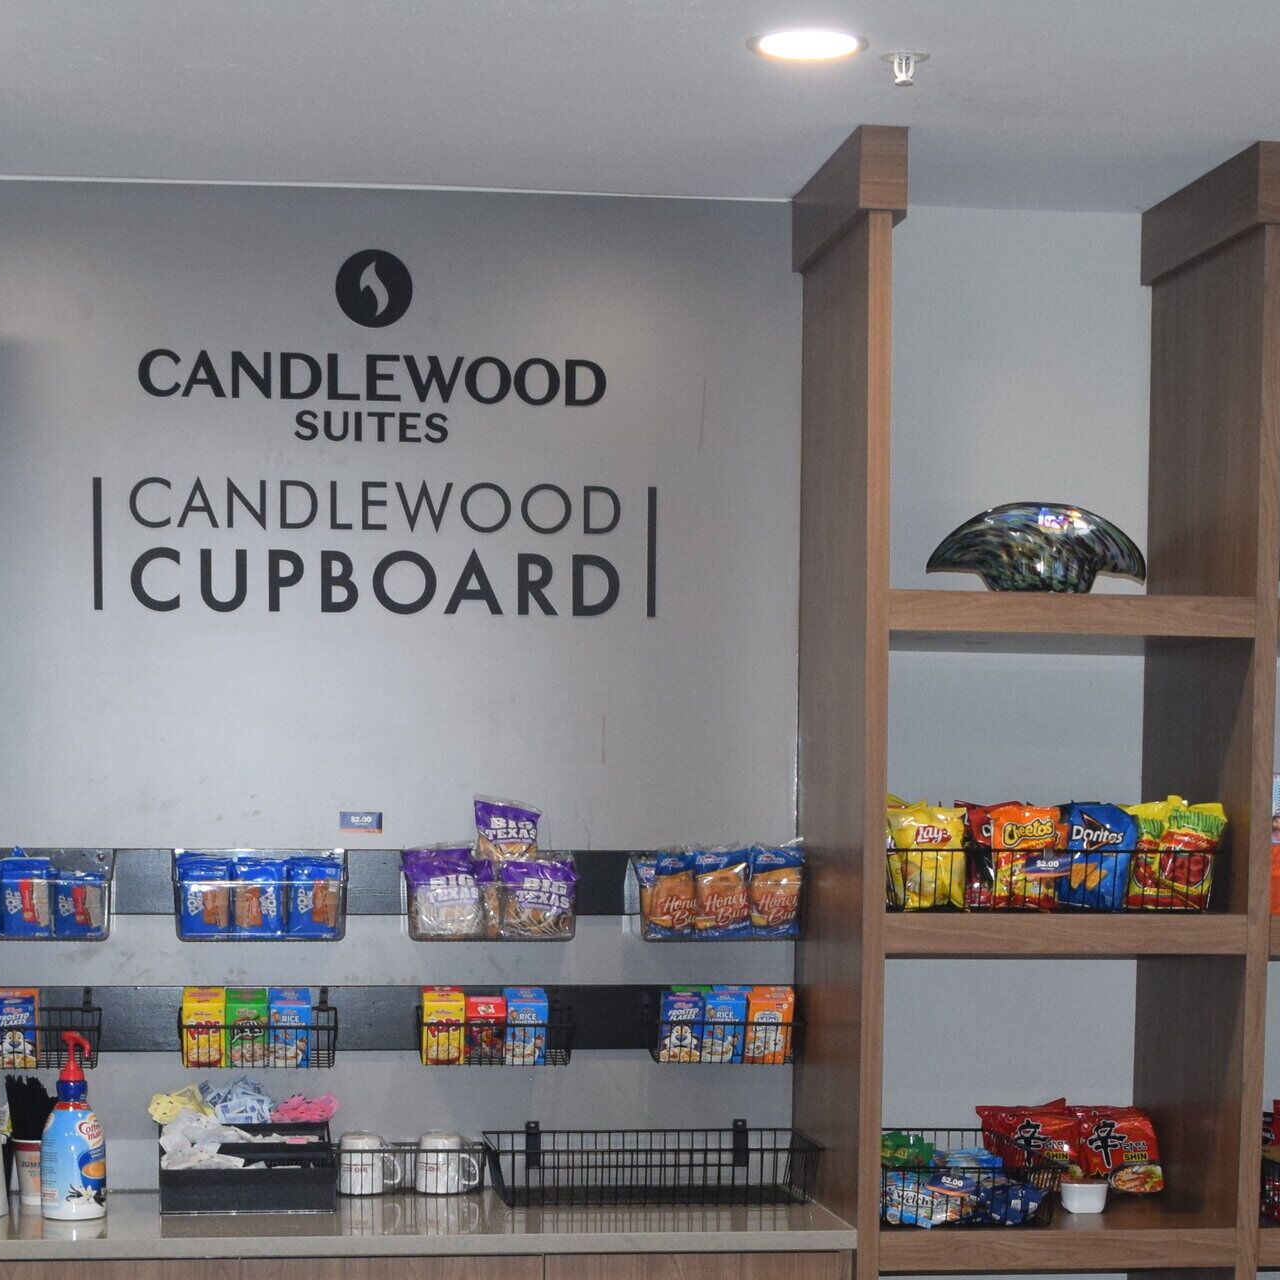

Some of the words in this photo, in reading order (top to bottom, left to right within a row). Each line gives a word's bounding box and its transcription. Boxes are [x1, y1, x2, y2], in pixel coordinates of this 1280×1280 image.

[137, 348, 607, 407] CANDLEWOOD
[294, 409, 449, 443] SUITES
[129, 475, 621, 535] CANDLEWOOD
[130, 546, 620, 617] CUPBOARD
[1004, 819, 1054, 846] Cheetos
[1071, 825, 1124, 843] Doritos
[1036, 860, 1059, 868] $2.00
[429, 874, 475, 890] BIG
[522, 877, 568, 895] BIG
[516, 890, 570, 908] TEXAS
[705, 893, 748, 913] Honey
[281, 1015, 300, 1023] RICE
[519, 1013, 537, 1021] RICE
[716, 1011, 734, 1019] RICE
[1045, 1152, 1069, 1160] SHIN
[1124, 1152, 1148, 1160] SHIN
[941, 1175, 964, 1187] $2.00
